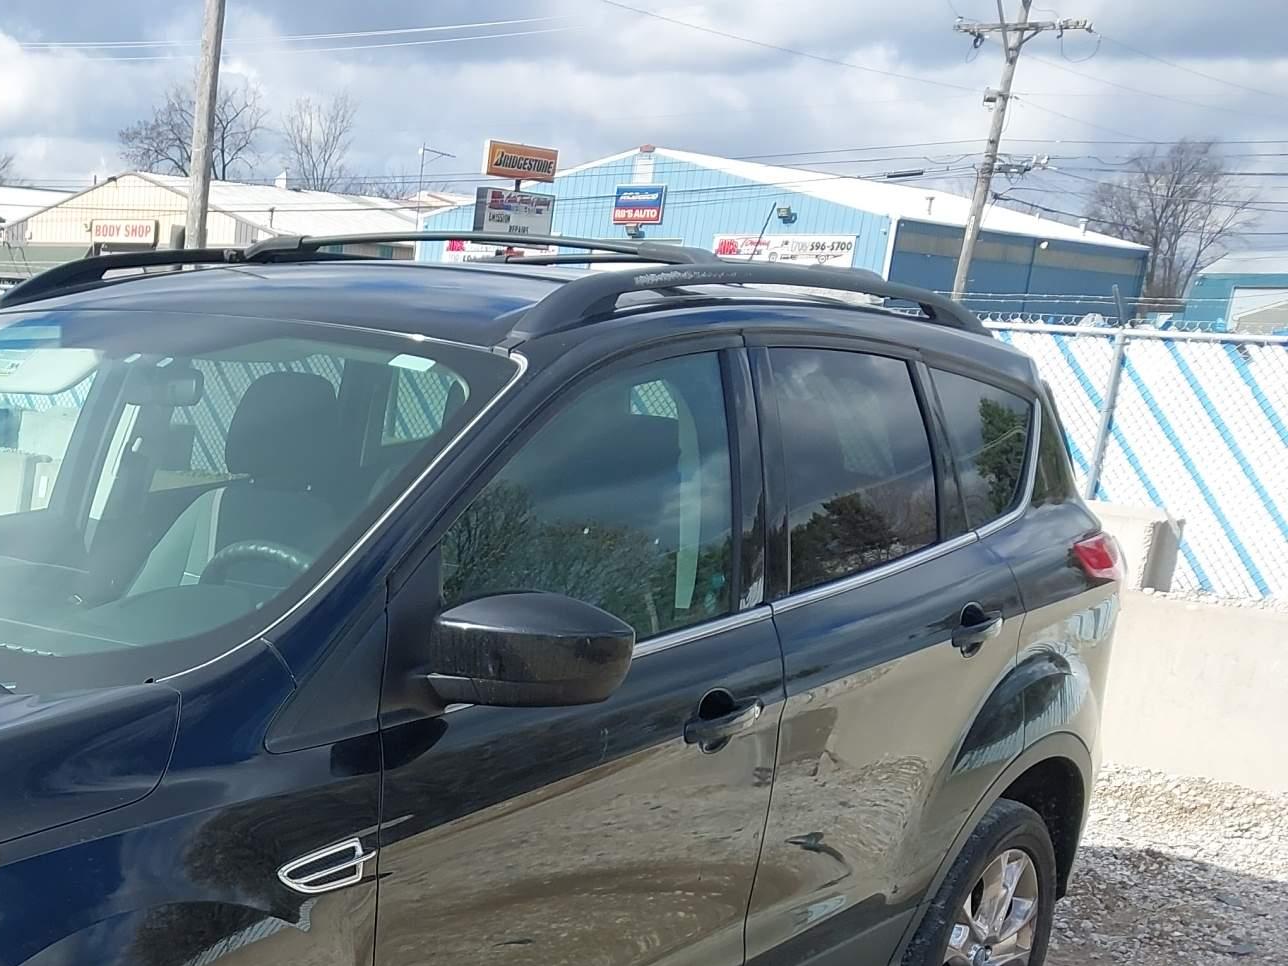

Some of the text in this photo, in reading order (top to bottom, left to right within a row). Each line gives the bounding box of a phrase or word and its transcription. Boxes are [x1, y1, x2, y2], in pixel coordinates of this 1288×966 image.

[494, 151, 554, 174] BRIDGESTONE
[633, 208, 658, 219] AUTO
[95, 223, 151, 237] BODY SHOP
